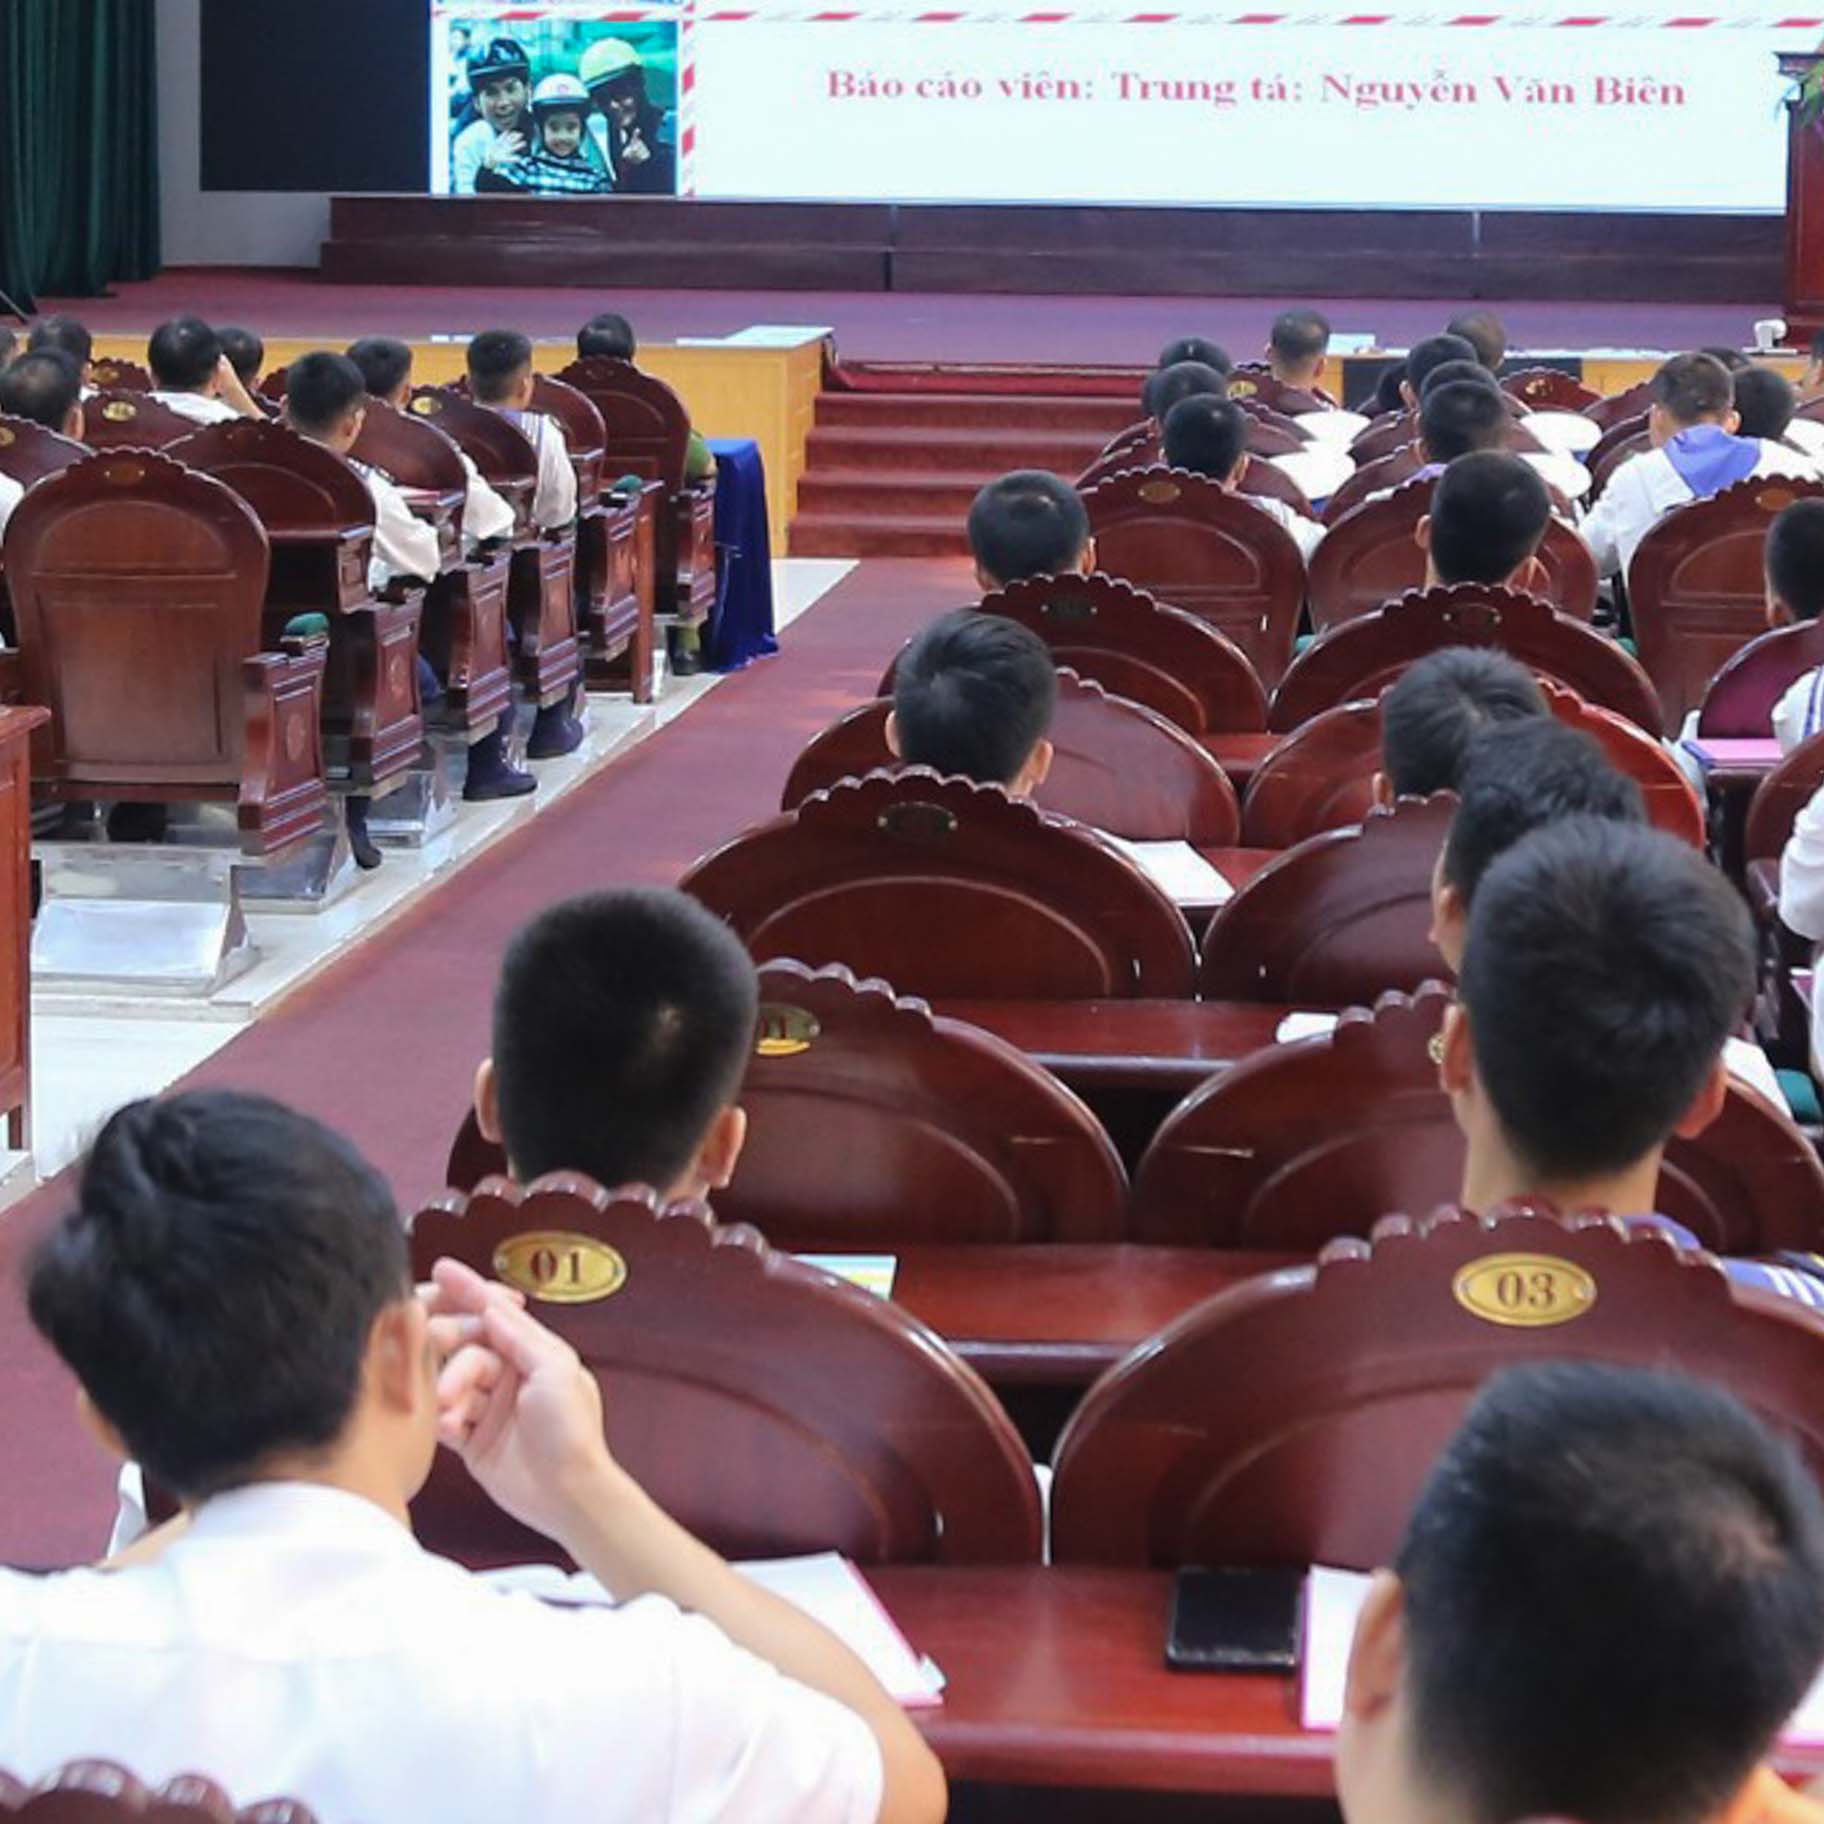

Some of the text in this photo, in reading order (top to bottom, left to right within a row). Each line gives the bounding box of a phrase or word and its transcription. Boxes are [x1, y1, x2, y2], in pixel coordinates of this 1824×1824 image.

[827, 70, 1686, 110] Báo cáo viên: Trung tá: Nguyễn Văn Biên
[528, 1249, 582, 1283] 01
[1495, 1272, 1553, 1310] 03
